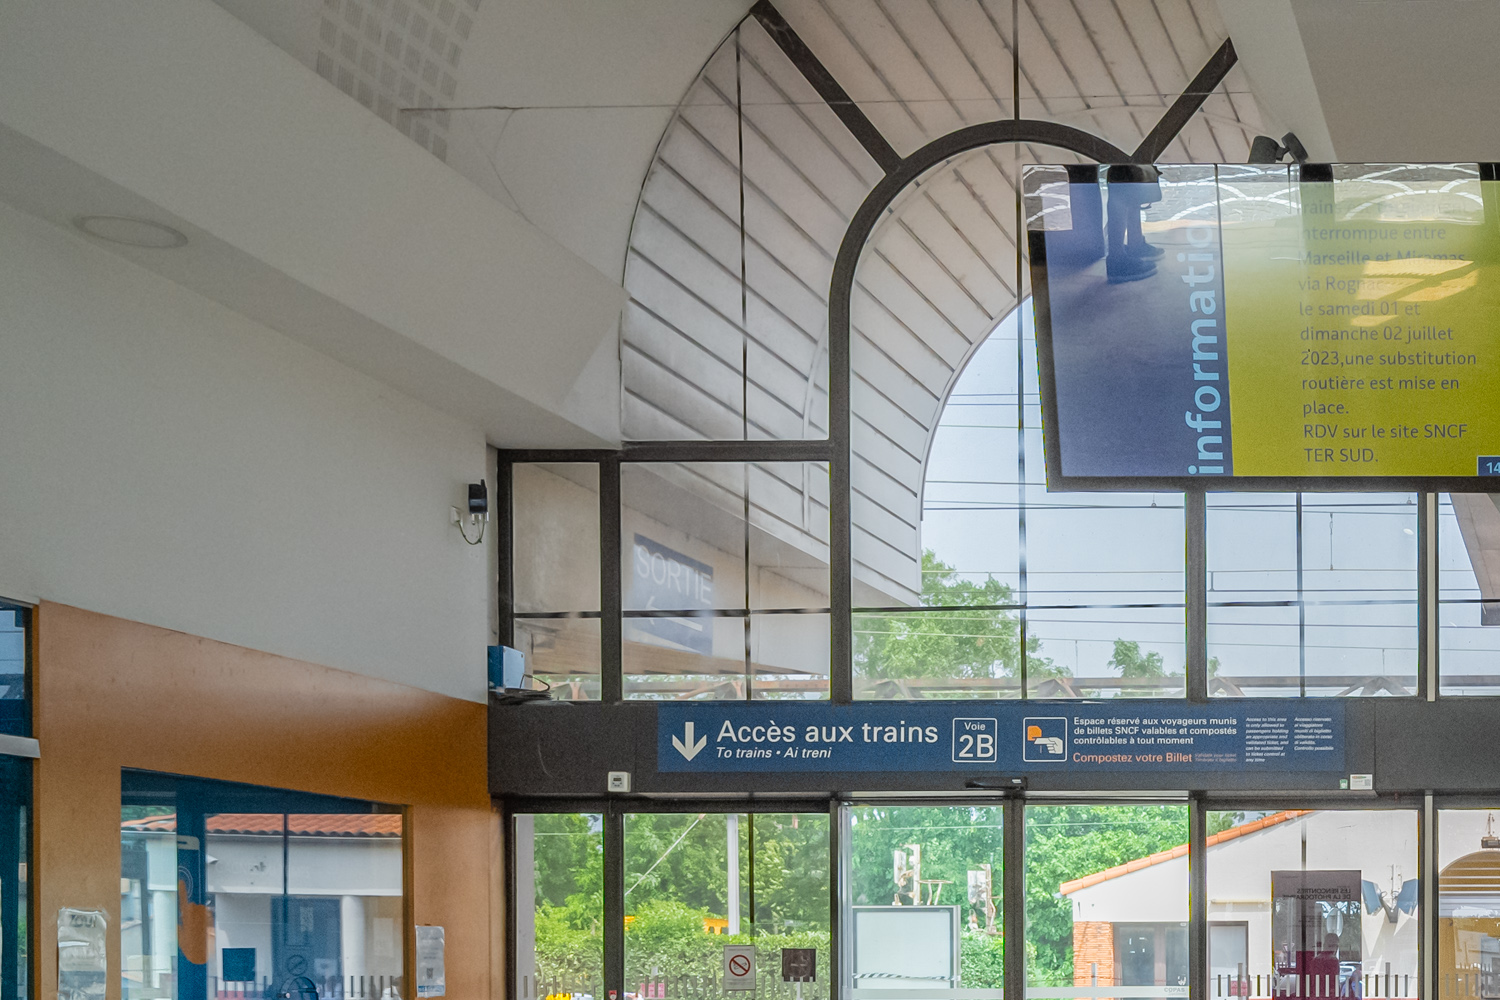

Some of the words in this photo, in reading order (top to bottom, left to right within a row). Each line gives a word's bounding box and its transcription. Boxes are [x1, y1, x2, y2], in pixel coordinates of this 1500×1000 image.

[1404, 228, 1446, 239] entre
[1300, 276, 1320, 290] via
[1300, 301, 1313, 315] le
[1318, 301, 1375, 315] samedi
[1380, 302, 1398, 315] 01
[1405, 303, 1420, 315] et
[1300, 326, 1378, 340] dimanche
[1383, 327, 1402, 340] 02
[1405, 326, 1454, 344] juillet
[1379, 350, 1476, 365] substitution
[1302, 375, 1365, 390] routière
[1369, 377, 1394, 390] est
[1399, 376, 1436, 390] mise
[1441, 379, 1459, 390] en
[1303, 401, 1349, 417] place.
[1304, 425, 1338, 438] RDV
[1343, 427, 1366, 438] sur
[1371, 424, 1385, 438] le
[1390, 424, 1419, 438] site
[1424, 424, 1467, 438] SNCF
[1304, 448, 1334, 462] TER
[1340, 448, 1379, 462] SUD.
[1486, 462, 1500, 474] 14
[636, 544, 712, 605] SORTIE
[964, 721, 986, 731] Voie
[1074, 717, 1104, 727] Espace
[1107, 717, 1140, 725] réservé
[1161, 718, 1207, 727] voyageurs
[717, 720, 796, 743] Accès
[805, 725, 853, 743] aux
[862, 720, 938, 743] trains
[1074, 727, 1085, 735] de
[1087, 727, 1113, 735] billets
[1115, 727, 1139, 735] SNCF
[1141, 727, 1176, 735] valables
[1178, 727, 1187, 735] et
[1189, 727, 1237, 737] compostés
[958, 734, 994, 758] 2B
[1074, 736, 1127, 745] contrôlables
[1130, 736, 1136, 744] à
[1138, 736, 1155, 744] tout
[1157, 736, 1194, 744] moment
[716, 747, 732, 758] To
[736, 747, 772, 758] trains
[784, 747, 798, 758] Ai
[802, 747, 831, 758] treni
[1073, 753, 1133, 764] Compostez
[1135, 754, 1163, 763] votre
[1166, 753, 1192, 763] Billet
